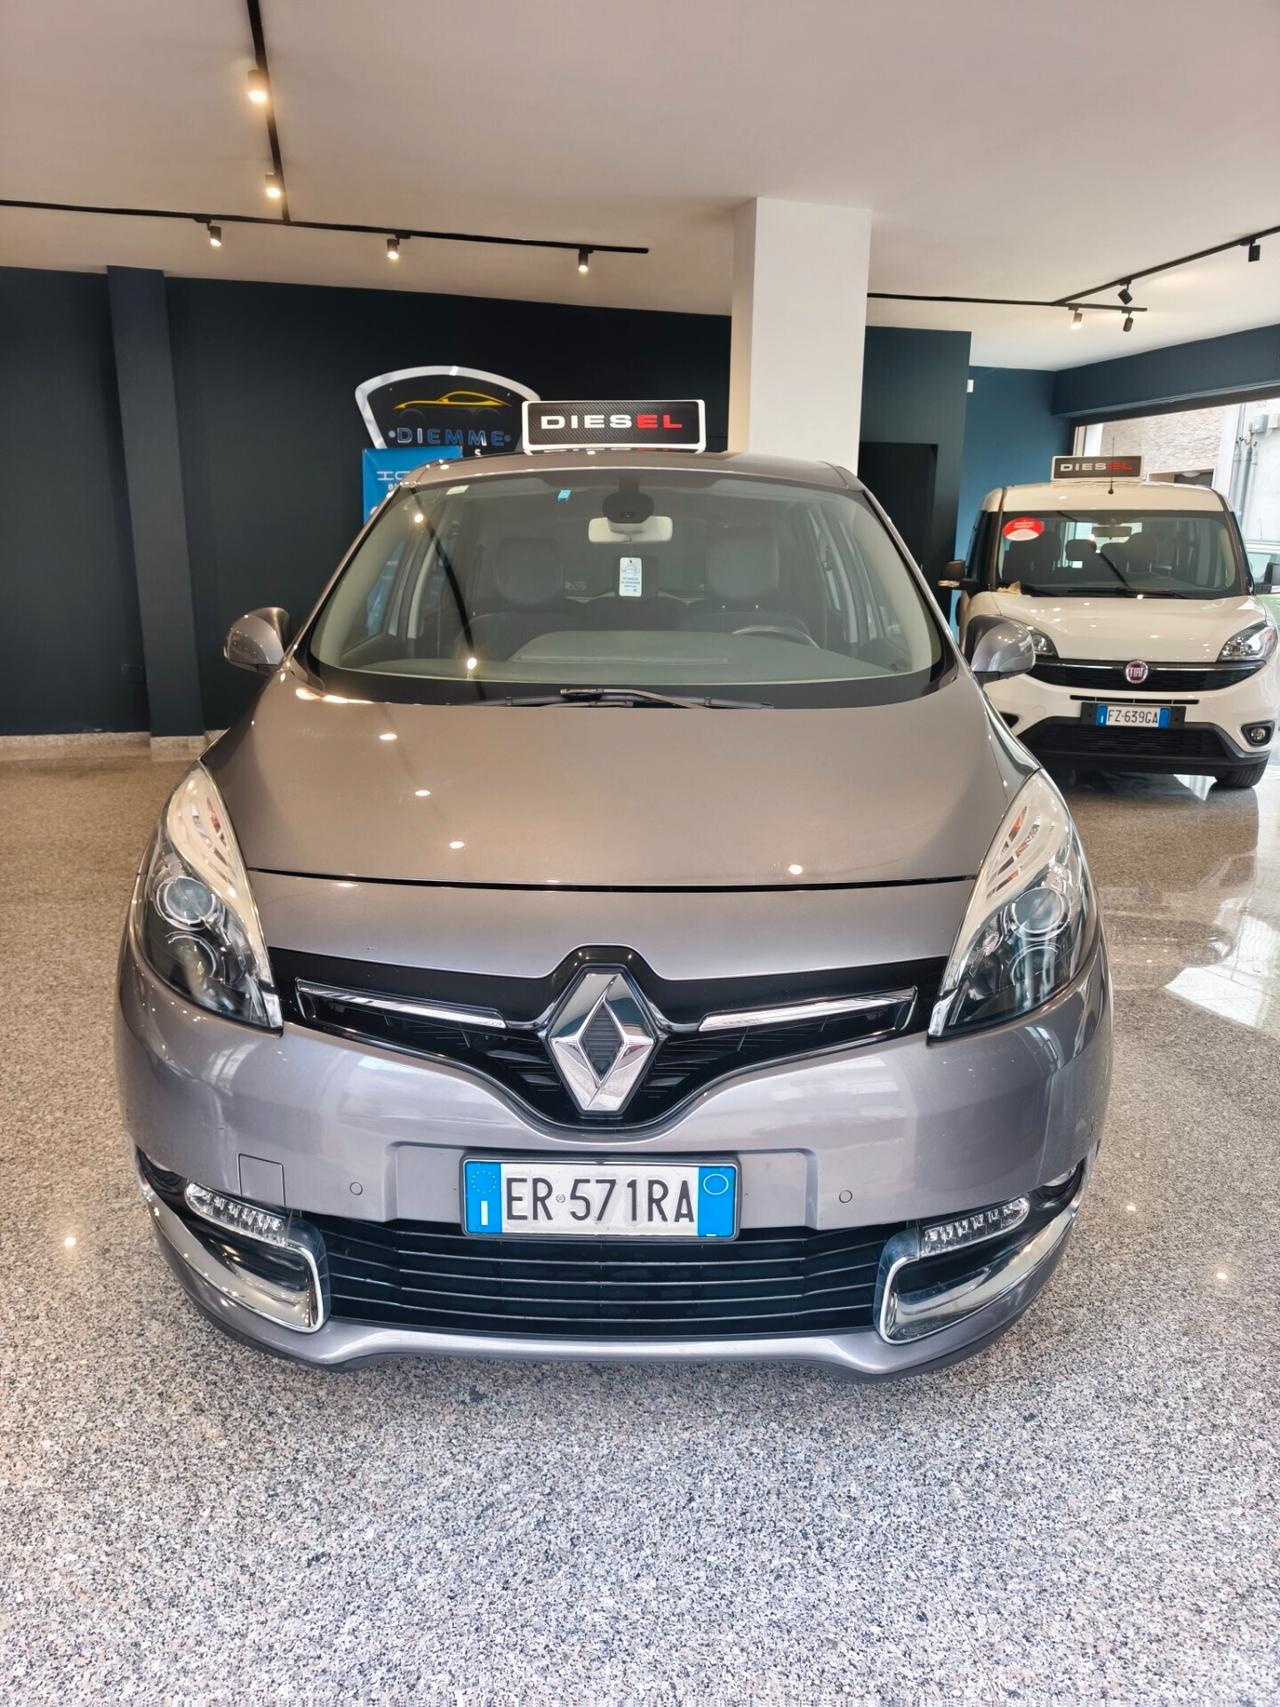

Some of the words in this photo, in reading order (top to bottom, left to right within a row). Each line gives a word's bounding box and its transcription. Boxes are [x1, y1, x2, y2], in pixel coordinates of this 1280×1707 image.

[541, 414, 683, 430] DIESEL
[396, 427, 505, 447] DIEMME
[1060, 462, 1134, 472] DIESEL
[1127, 667, 1144, 678] FIAT
